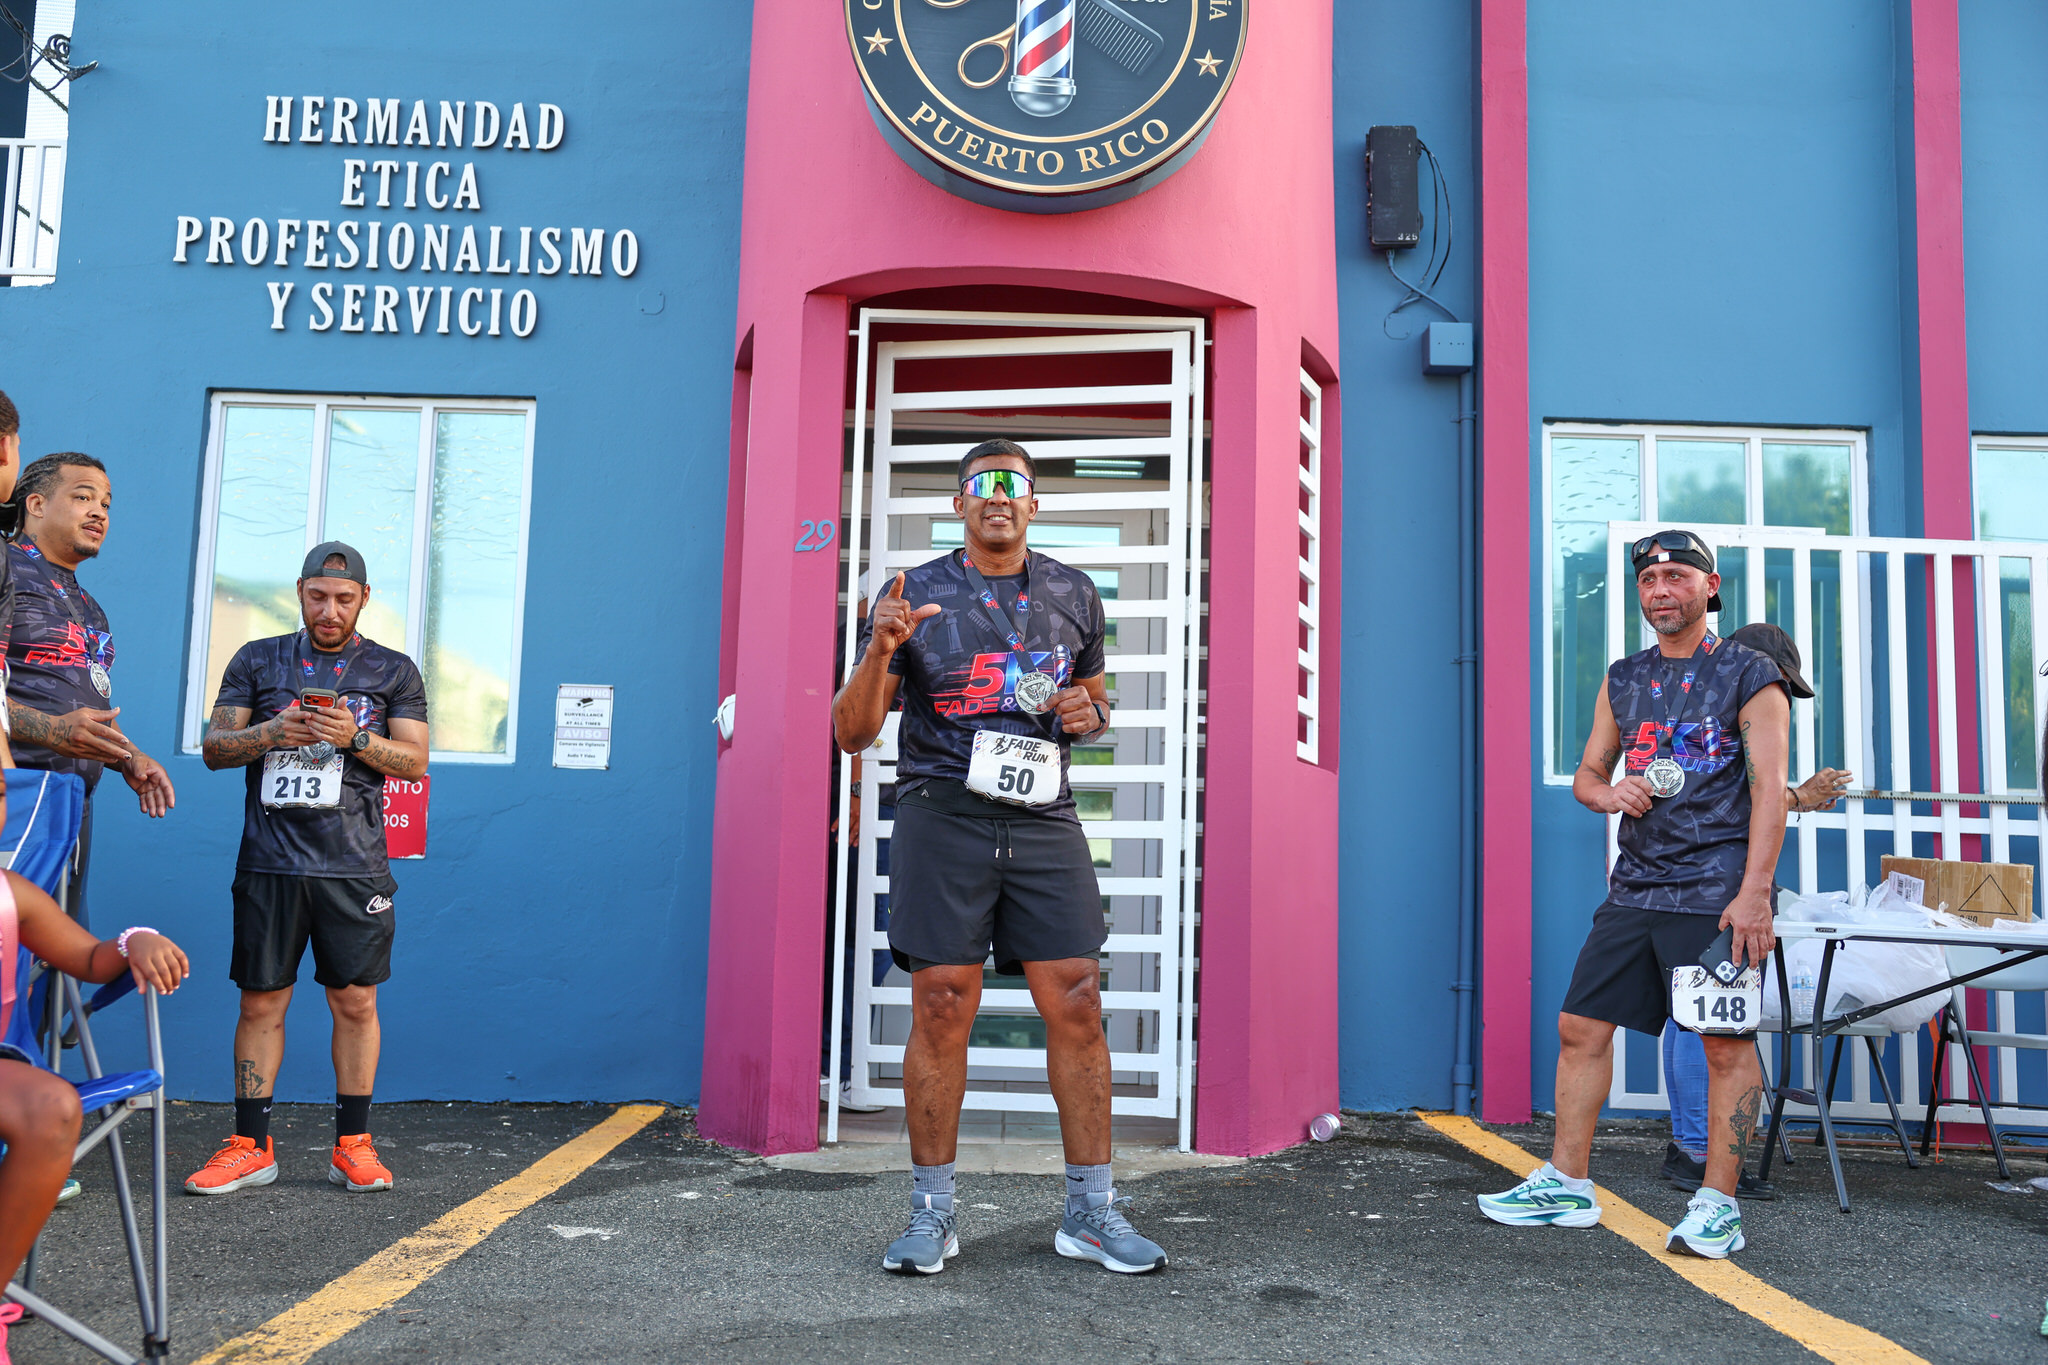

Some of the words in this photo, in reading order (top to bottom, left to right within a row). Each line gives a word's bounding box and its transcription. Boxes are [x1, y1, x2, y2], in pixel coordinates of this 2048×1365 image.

[263, 96, 565, 150] HERMANDAD
[907, 101, 1064, 175] PUERTO
[1076, 118, 1169, 173] RICO
[340, 159, 481, 210] ETICA
[172, 216, 639, 277] PROFESIONALISMO
[267, 282, 294, 330] Y
[309, 282, 538, 337] SERVICIO
[795, 519, 836, 552] 29
[25, 650, 87, 668] FADE
[560, 688, 608, 697] WARNING
[934, 697, 1000, 717] FADE
[563, 729, 602, 738] AVISO
[1008, 738, 1042, 752] FADE
[301, 762, 325, 771] RUN
[1023, 751, 1048, 763] RUN
[274, 776, 321, 799] 213
[997, 764, 1035, 795] 50
[1693, 995, 1747, 1022] 148
